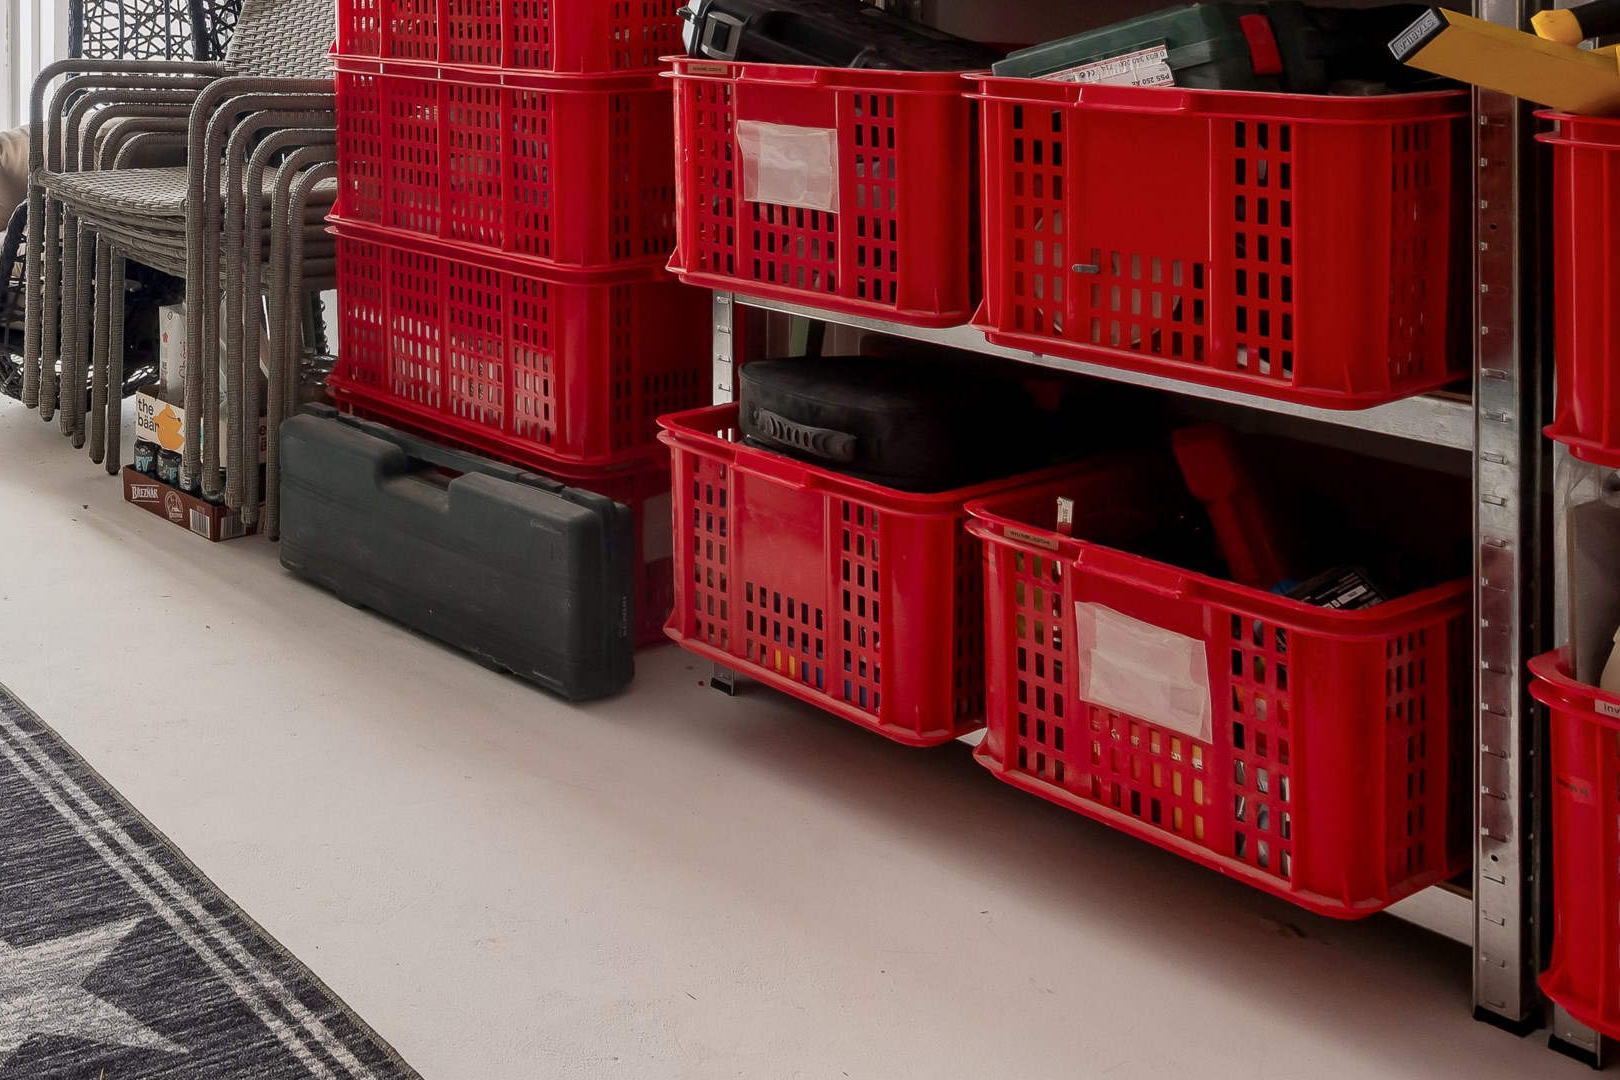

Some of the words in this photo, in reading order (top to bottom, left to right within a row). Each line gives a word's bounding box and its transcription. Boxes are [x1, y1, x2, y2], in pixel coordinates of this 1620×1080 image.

[1398, 18, 1435, 52] STABILA
[1132, 56, 1144, 64] 340
[1145, 52, 1158, 62] 603
[1142, 77, 1154, 85] 250
[1155, 73, 1170, 81] PSS
[137, 398, 154, 415] the
[137, 414, 159, 433] bäär
